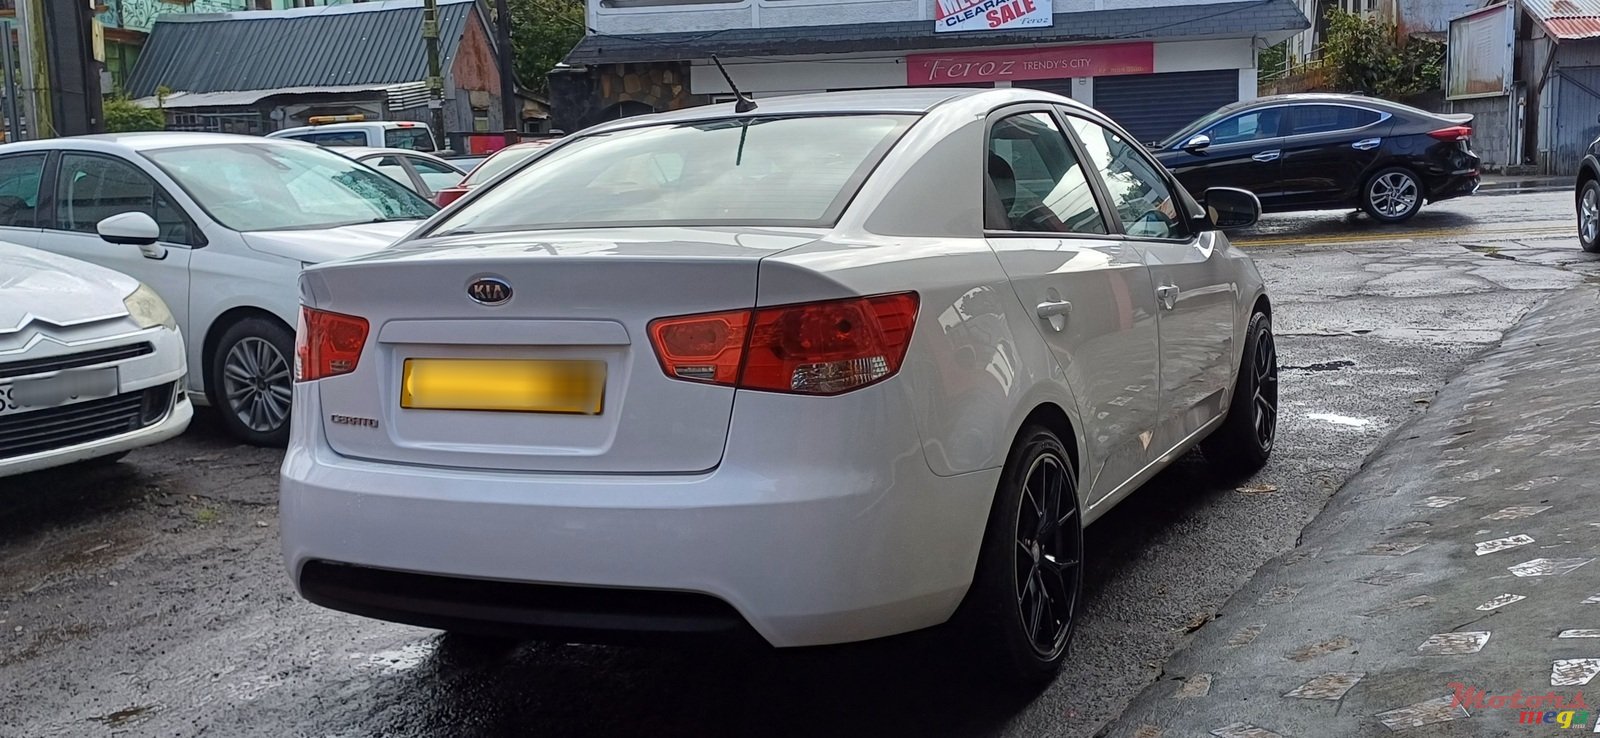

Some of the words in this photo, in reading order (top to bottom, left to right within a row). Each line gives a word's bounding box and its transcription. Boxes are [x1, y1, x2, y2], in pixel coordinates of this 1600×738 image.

[986, 0, 1036, 28] SALE
[1020, 17, 1049, 25] Feroz
[924, 58, 1015, 81] Feroz
[1023, 60, 1068, 71] TRENDY'S
[1069, 58, 1092, 69] CITY
[473, 284, 505, 299] KIA
